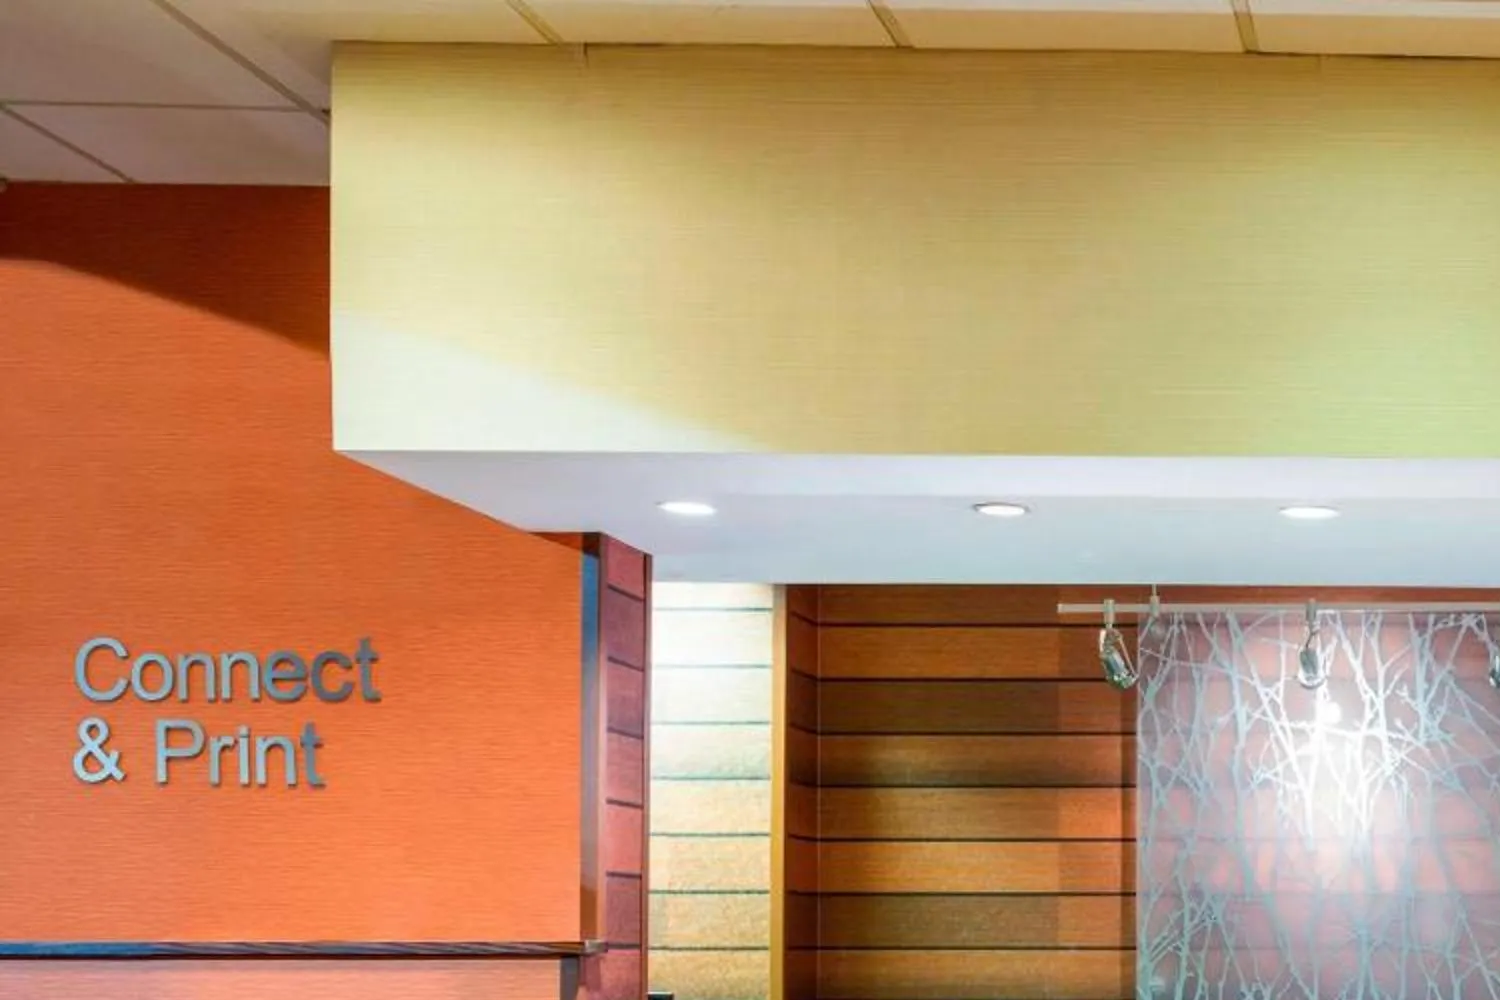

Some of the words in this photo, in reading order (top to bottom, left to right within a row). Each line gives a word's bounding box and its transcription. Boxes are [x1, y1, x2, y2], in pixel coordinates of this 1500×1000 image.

[74, 636, 382, 702] Connect
[72, 716, 126, 785] &
[154, 718, 327, 788] Print
